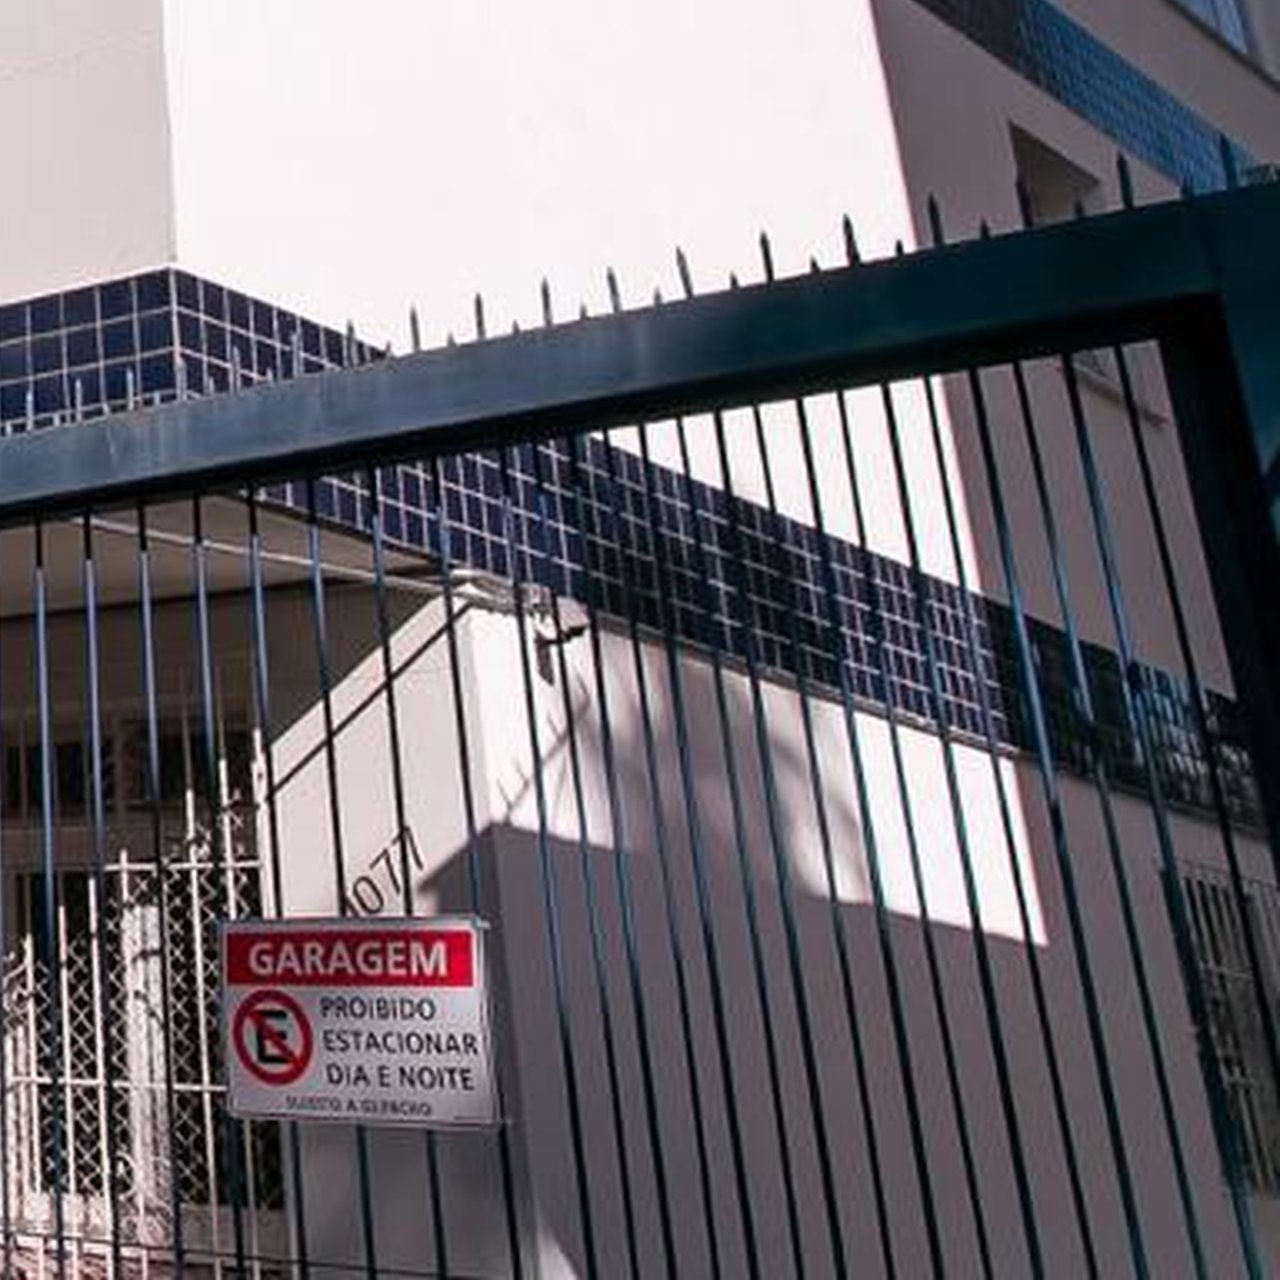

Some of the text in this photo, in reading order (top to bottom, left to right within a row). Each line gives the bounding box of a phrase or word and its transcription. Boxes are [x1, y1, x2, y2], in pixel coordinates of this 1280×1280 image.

[248, 939, 448, 977] GARAGEM
[319, 995, 436, 1021] PROIBIDO
[323, 1029, 479, 1055] ESTACIONAR
[326, 1062, 475, 1091] DIA E NOITE
